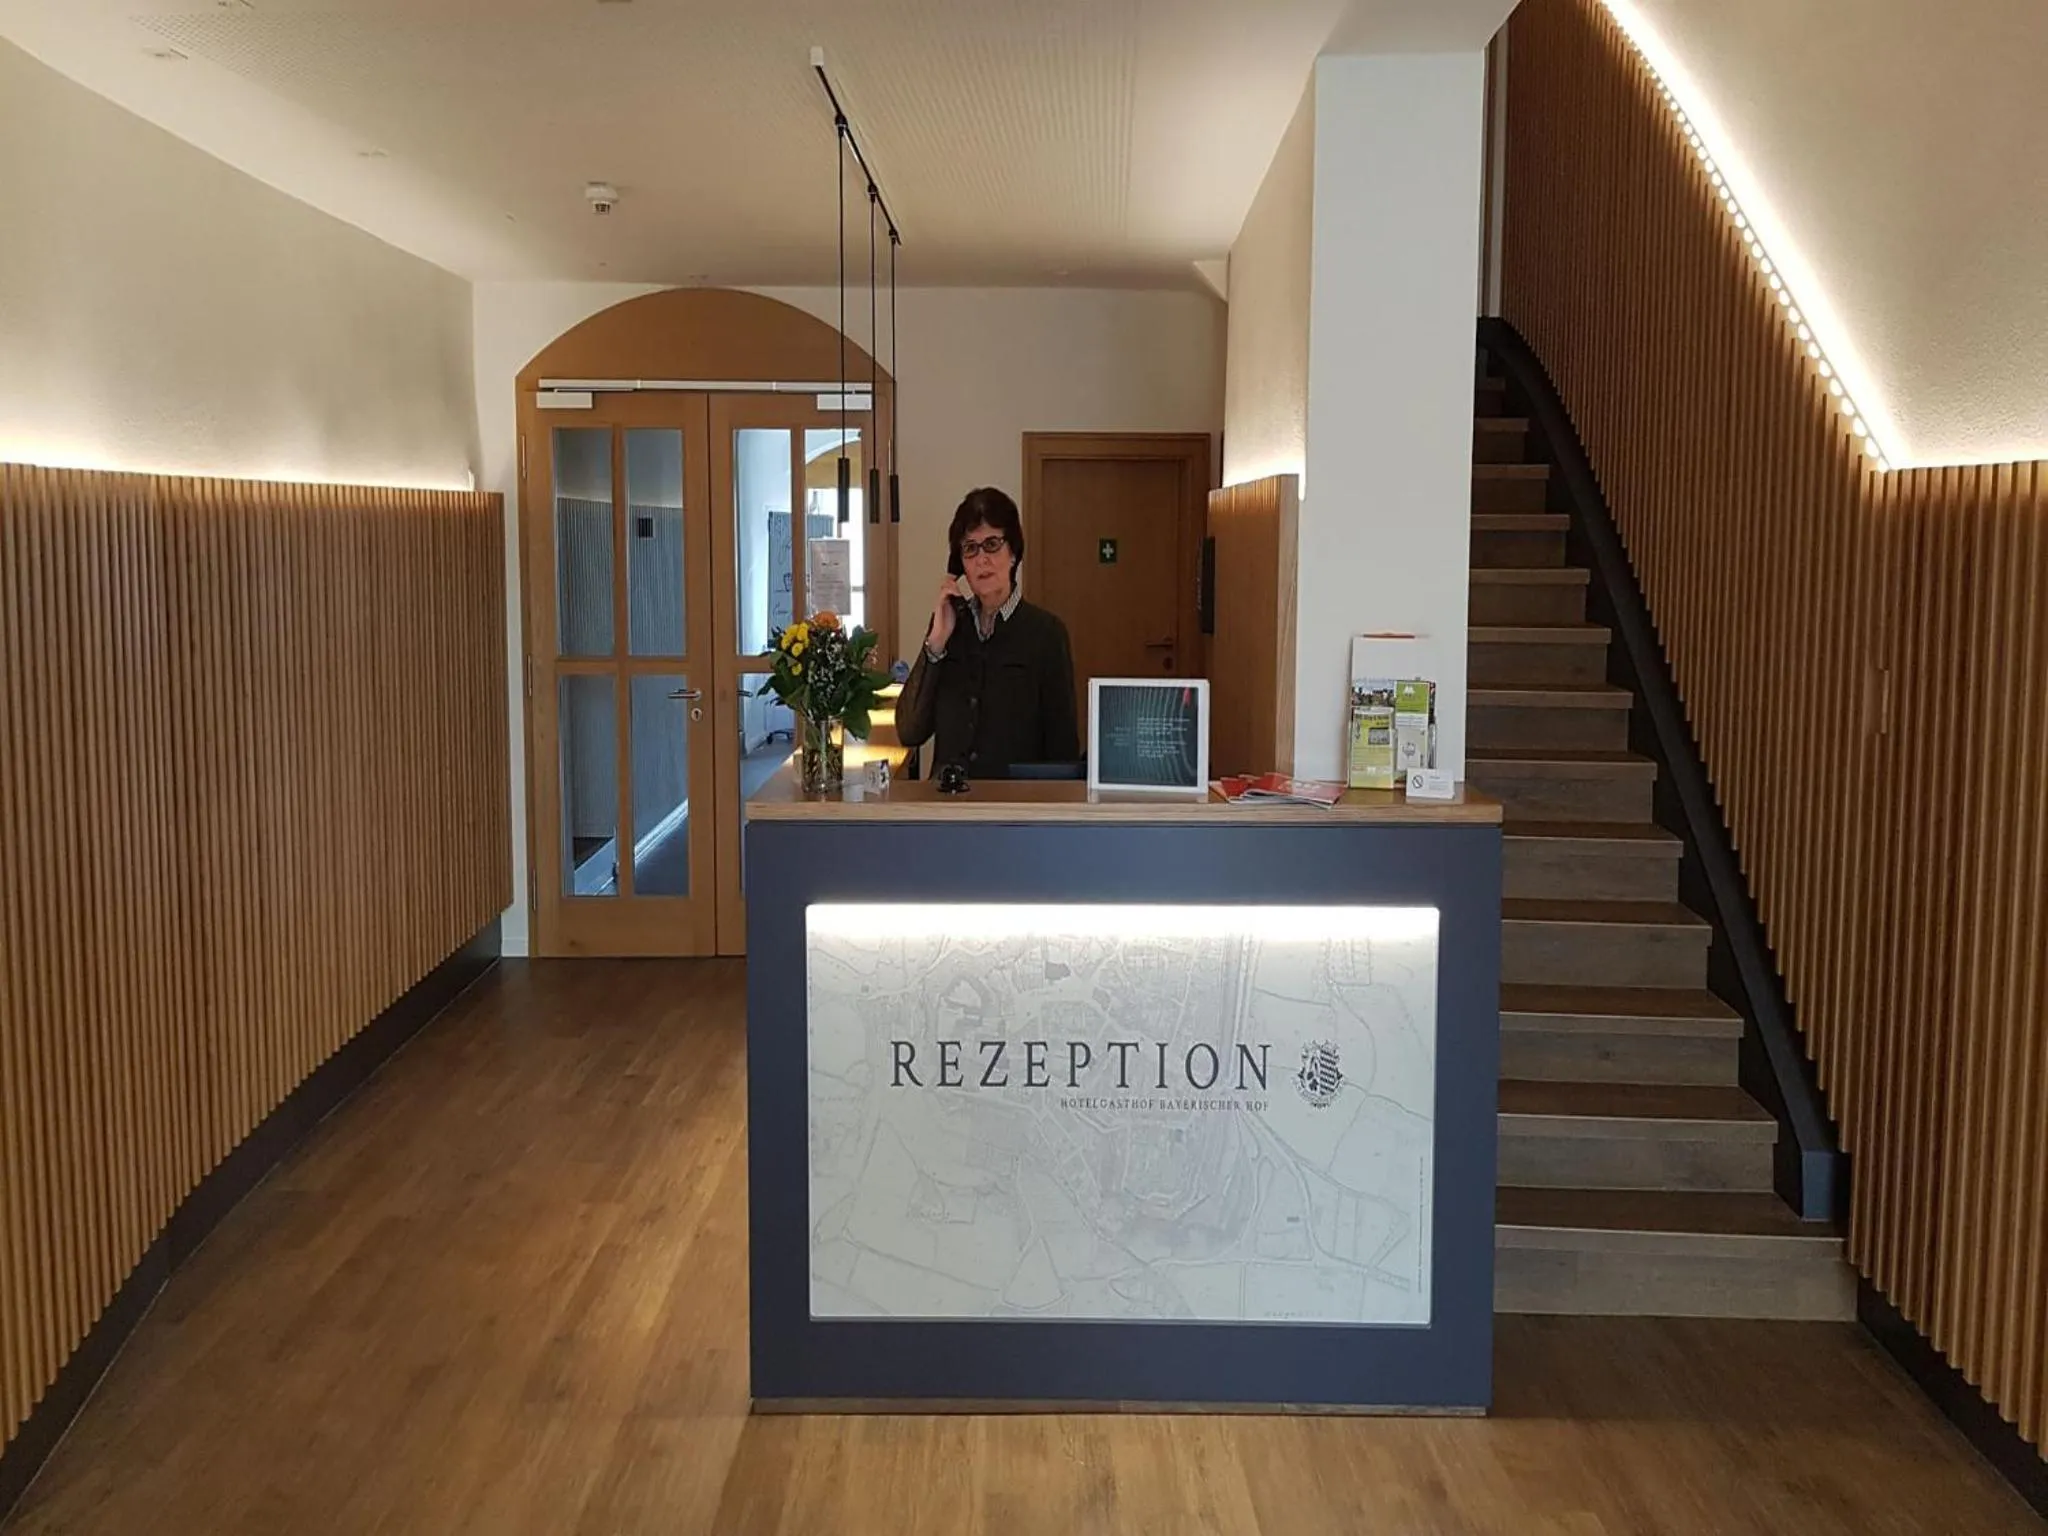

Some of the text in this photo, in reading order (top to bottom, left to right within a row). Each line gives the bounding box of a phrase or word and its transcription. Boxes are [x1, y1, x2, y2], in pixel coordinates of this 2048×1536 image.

[890, 1040, 1273, 1091] REZEPTION
[1060, 1097, 1269, 1112] HOTELGASTHOF BAYERISCHER HOF
